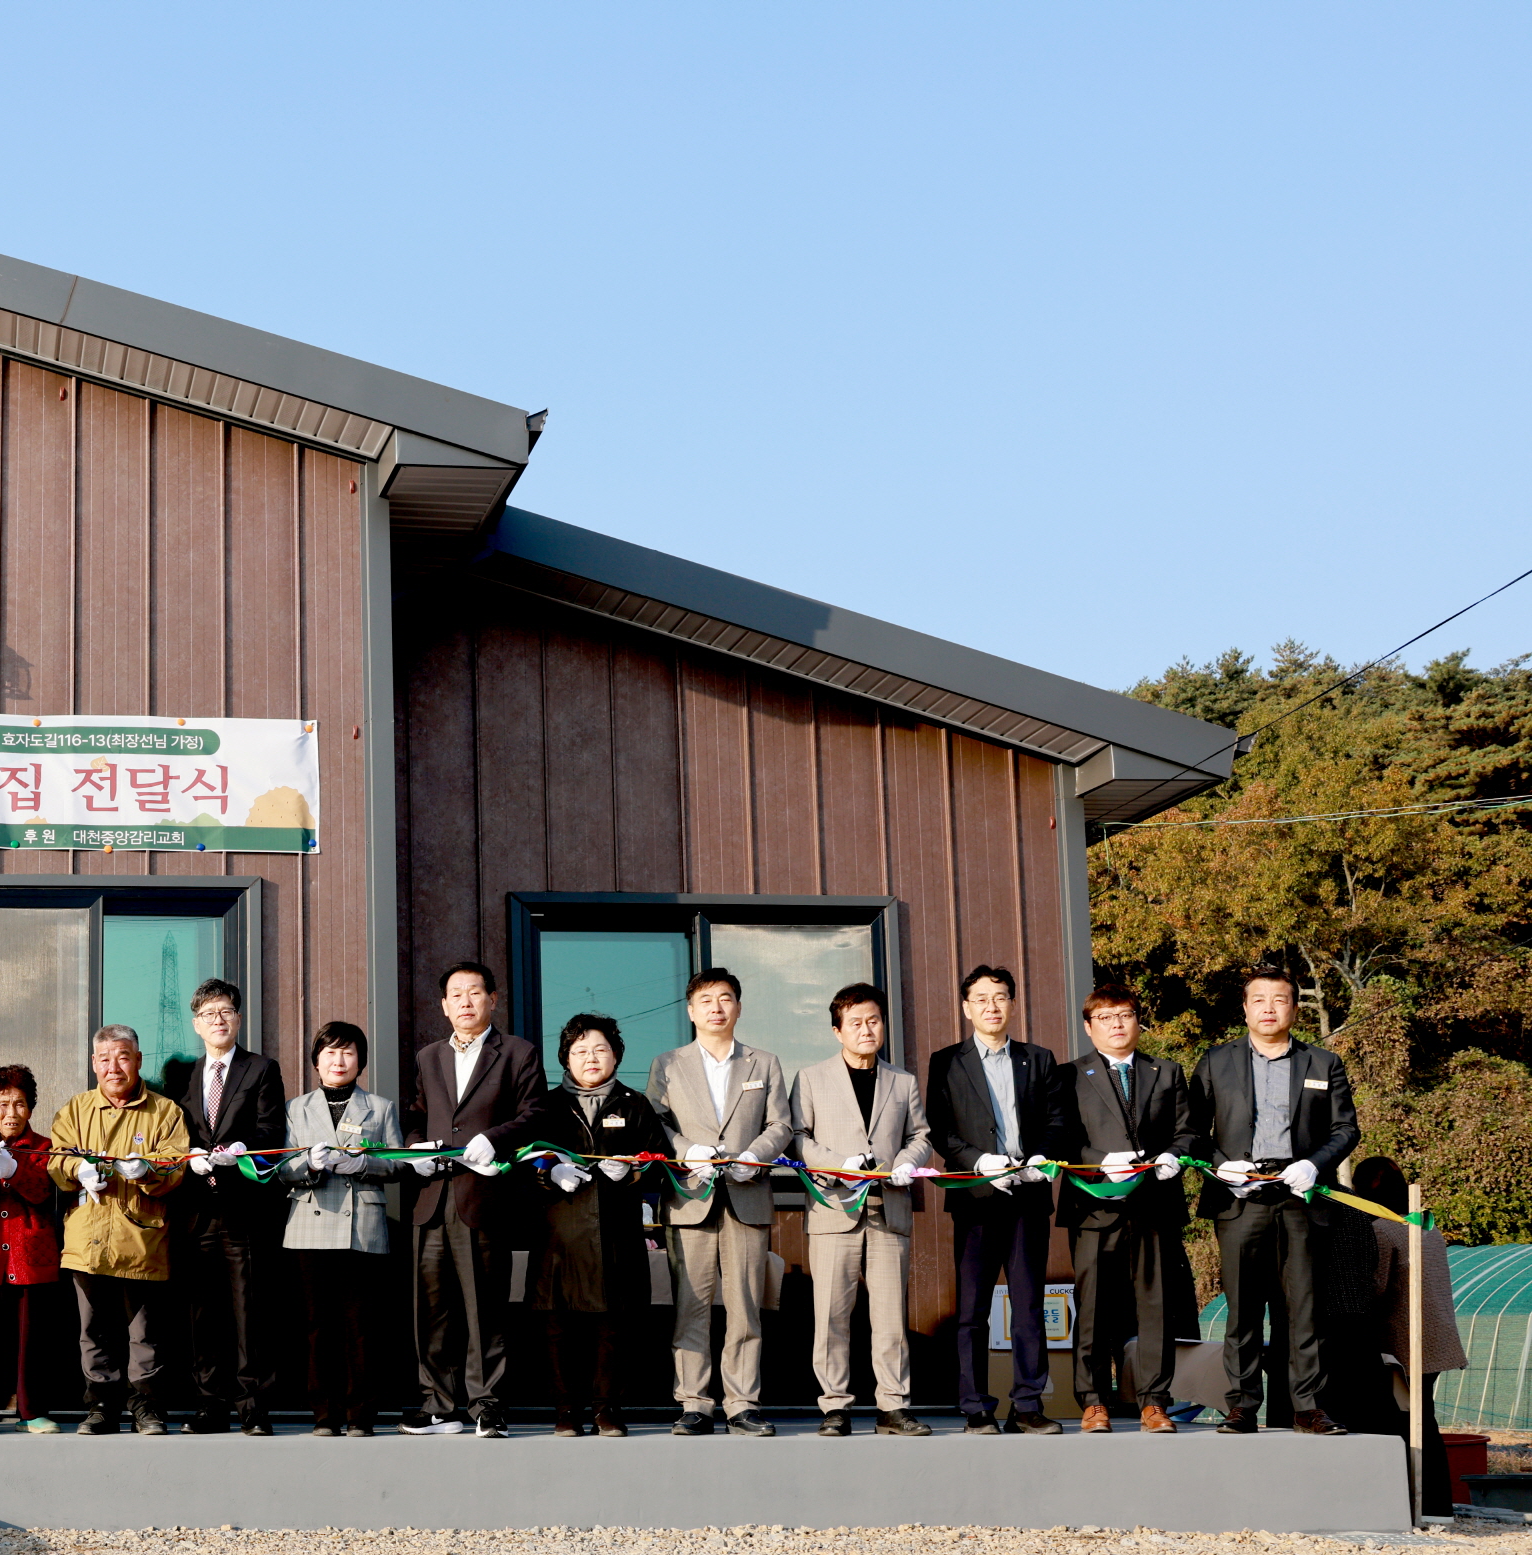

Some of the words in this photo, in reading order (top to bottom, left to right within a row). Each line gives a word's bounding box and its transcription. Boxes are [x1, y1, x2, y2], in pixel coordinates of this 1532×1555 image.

[170, 735, 204, 750] 가정)
[71, 762, 230, 815] 전달식
[73, 830, 185, 846] 대천중앙감리교회
